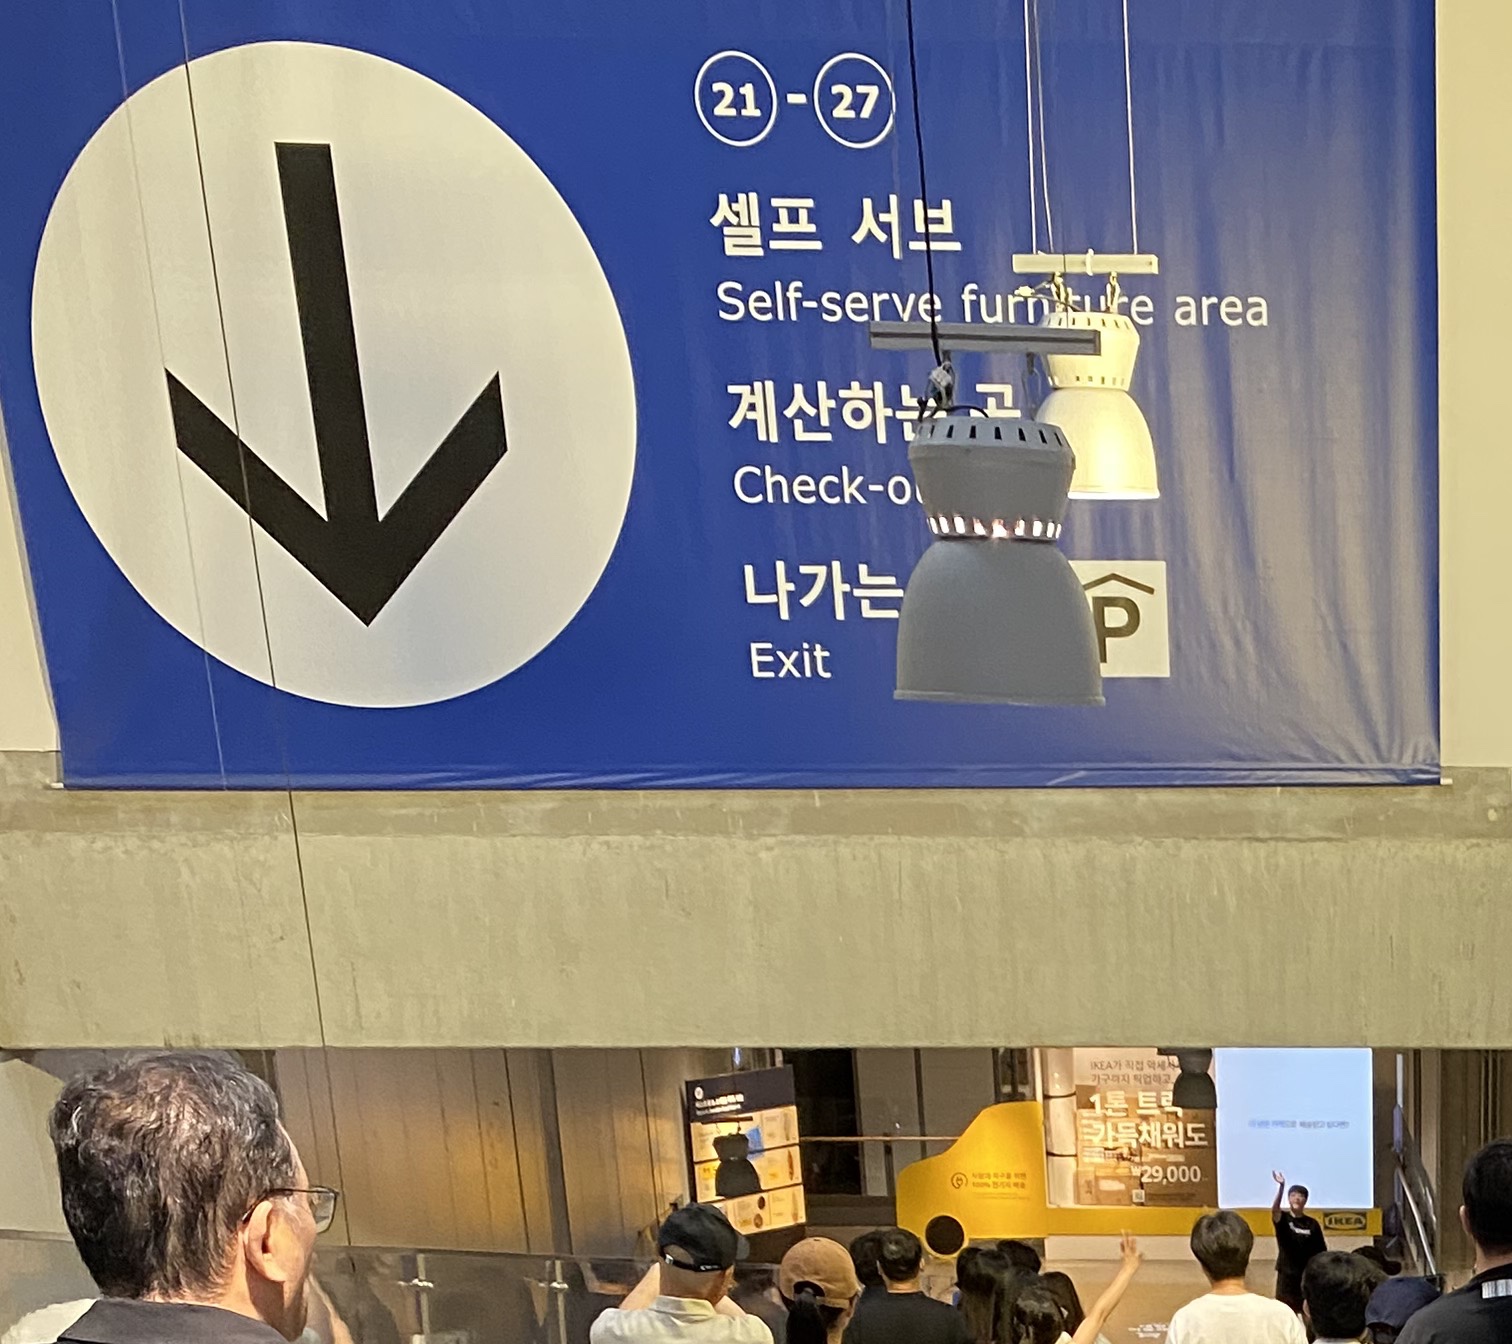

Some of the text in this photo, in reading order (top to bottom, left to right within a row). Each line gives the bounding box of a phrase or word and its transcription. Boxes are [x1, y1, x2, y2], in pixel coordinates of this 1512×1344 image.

[711, 81, 762, 118] 21
[830, 83, 880, 119] 27
[710, 191, 962, 260] 셀프 서브
[716, 280, 943, 323] Self-serve
[1174, 293, 1270, 328] area
[733, 464, 925, 505] Check-o
[743, 559, 905, 622] 나가는
[1099, 595, 1141, 664] P
[749, 641, 833, 679] Exit
